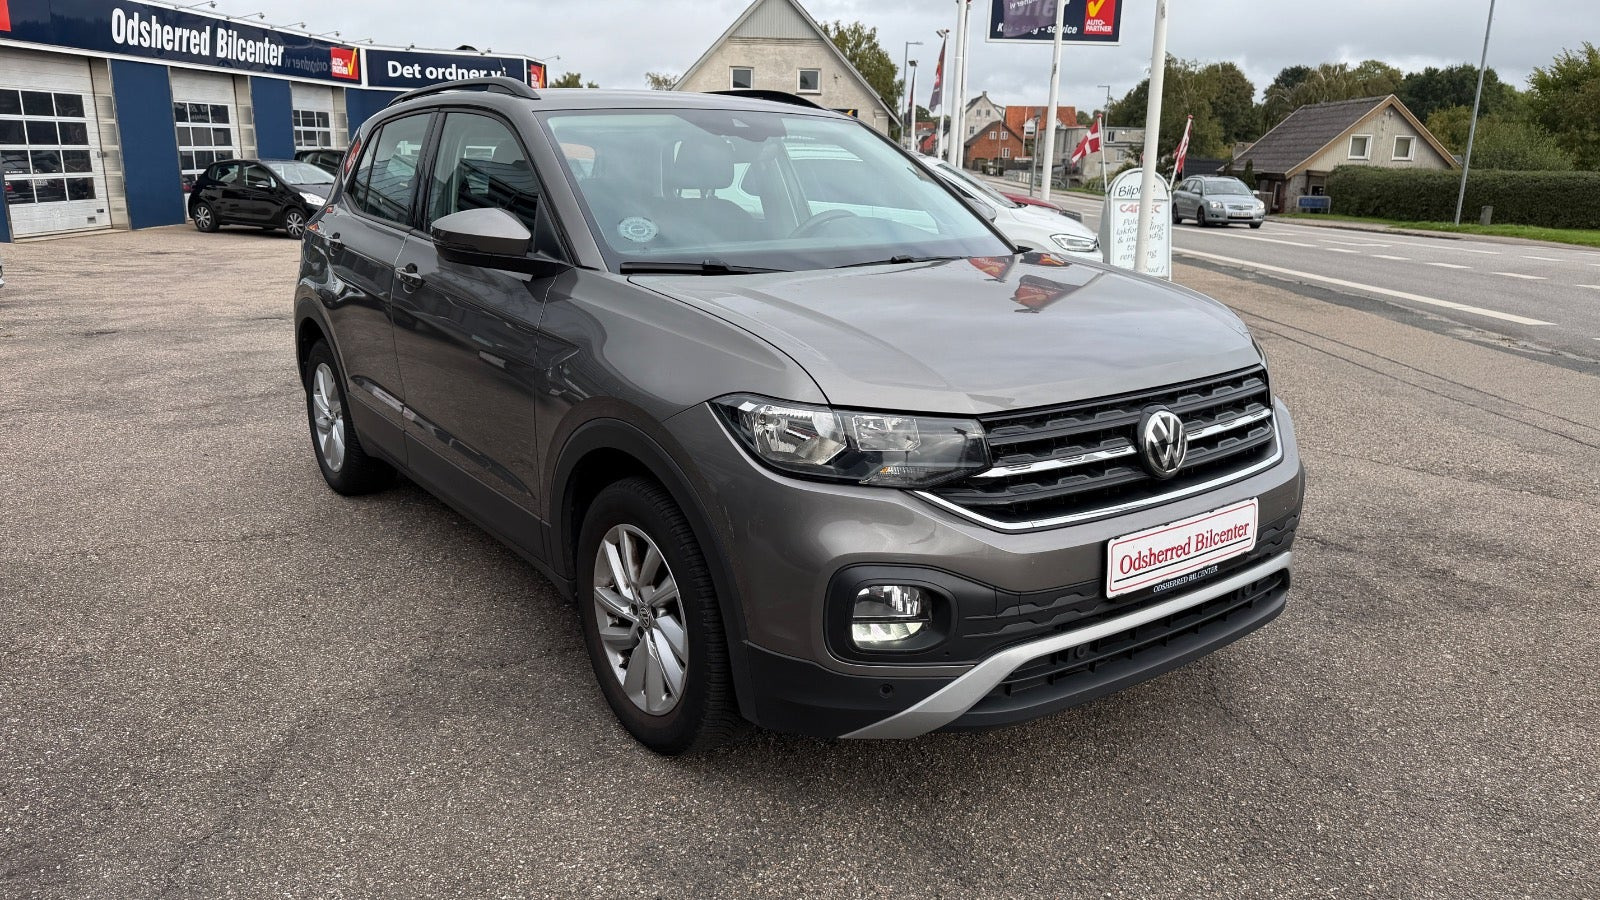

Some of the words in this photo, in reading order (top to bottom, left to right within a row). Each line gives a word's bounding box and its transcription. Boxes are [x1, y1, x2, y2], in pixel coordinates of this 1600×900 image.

[111, 7, 211, 56] Odsherred
[216, 28, 285, 67] Bilcenter
[1046, 25, 1078, 33] sevice
[387, 61, 422, 78] Det
[1119, 536, 1191, 575] Odsherred
[1195, 522, 1250, 553] Bilcenter
[1153, 575, 1188, 593] ODSHERRED
[1188, 565, 1218, 581] BILCENTER
